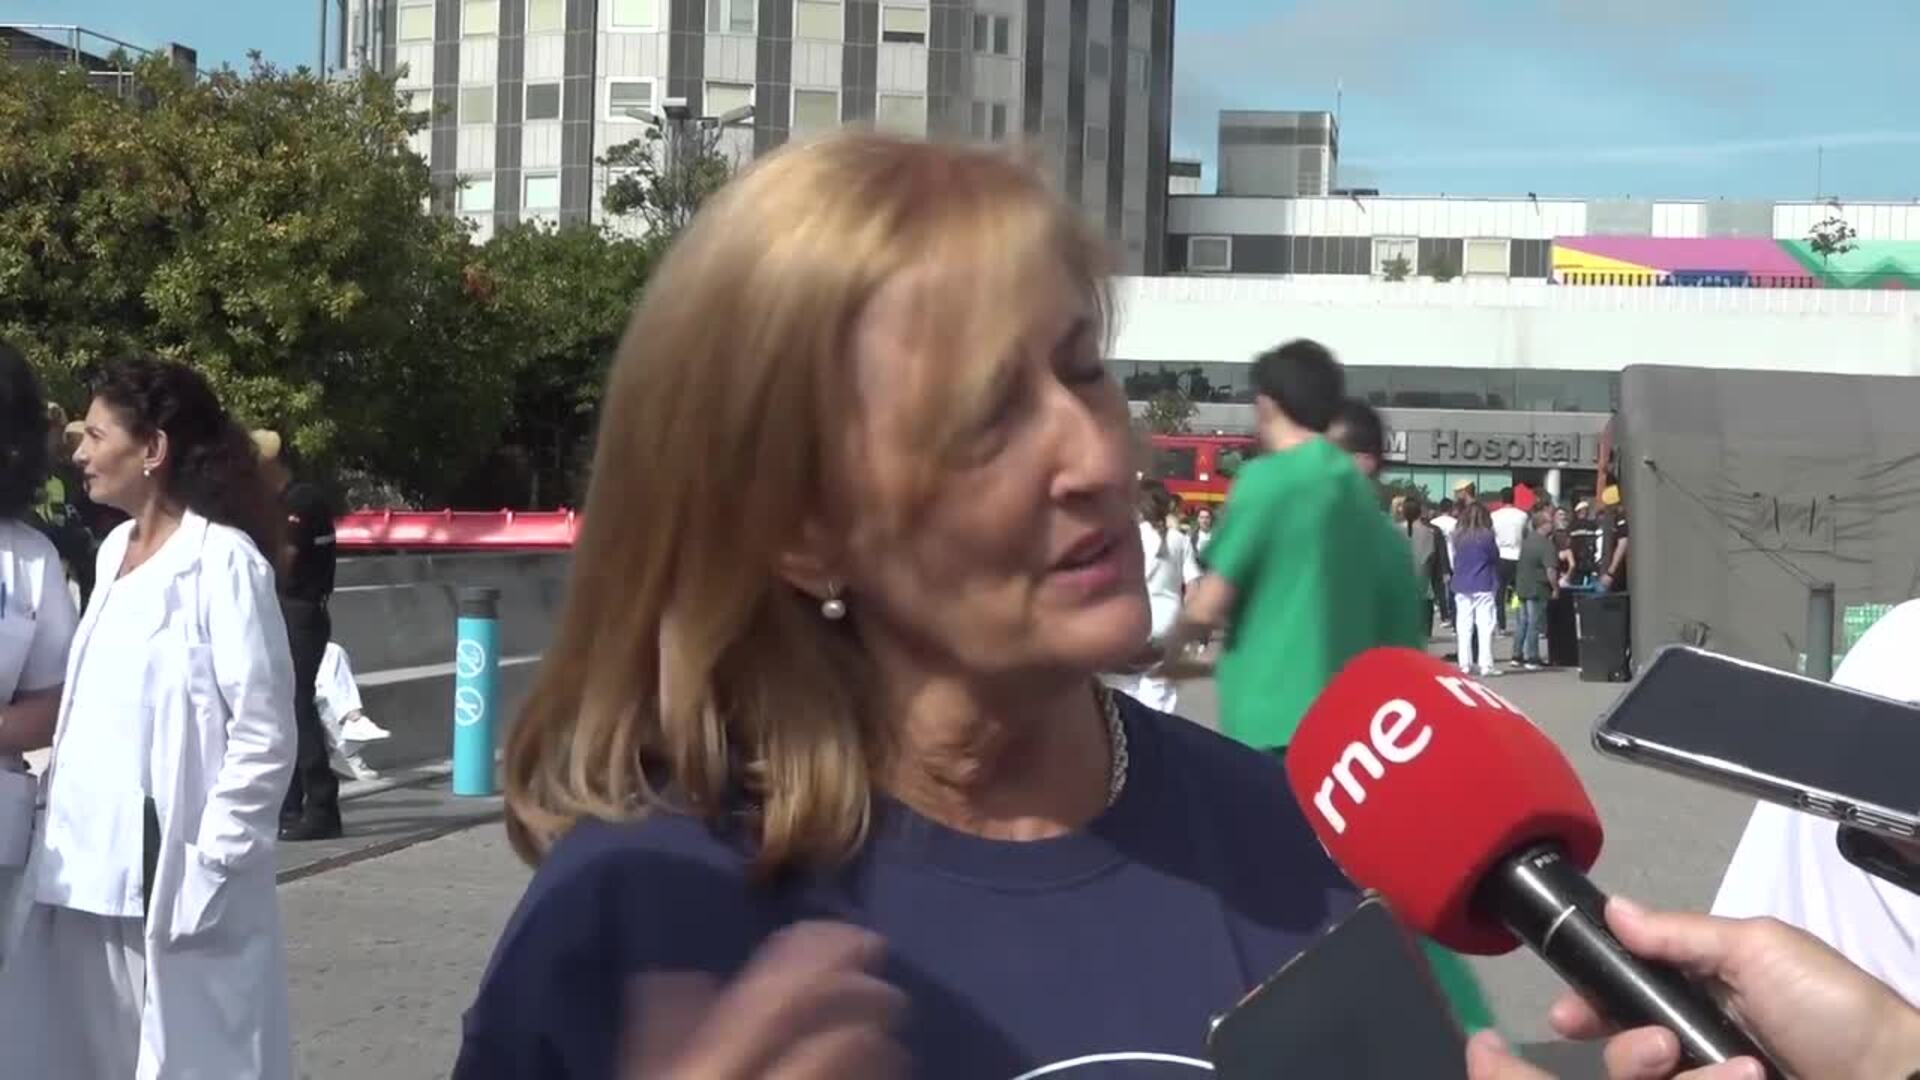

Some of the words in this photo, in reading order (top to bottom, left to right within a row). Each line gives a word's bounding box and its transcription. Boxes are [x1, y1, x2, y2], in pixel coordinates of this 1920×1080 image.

[1431, 430, 1580, 466] Hospital
[1435, 676, 1525, 716] rn
[1313, 698, 1432, 834] rne
